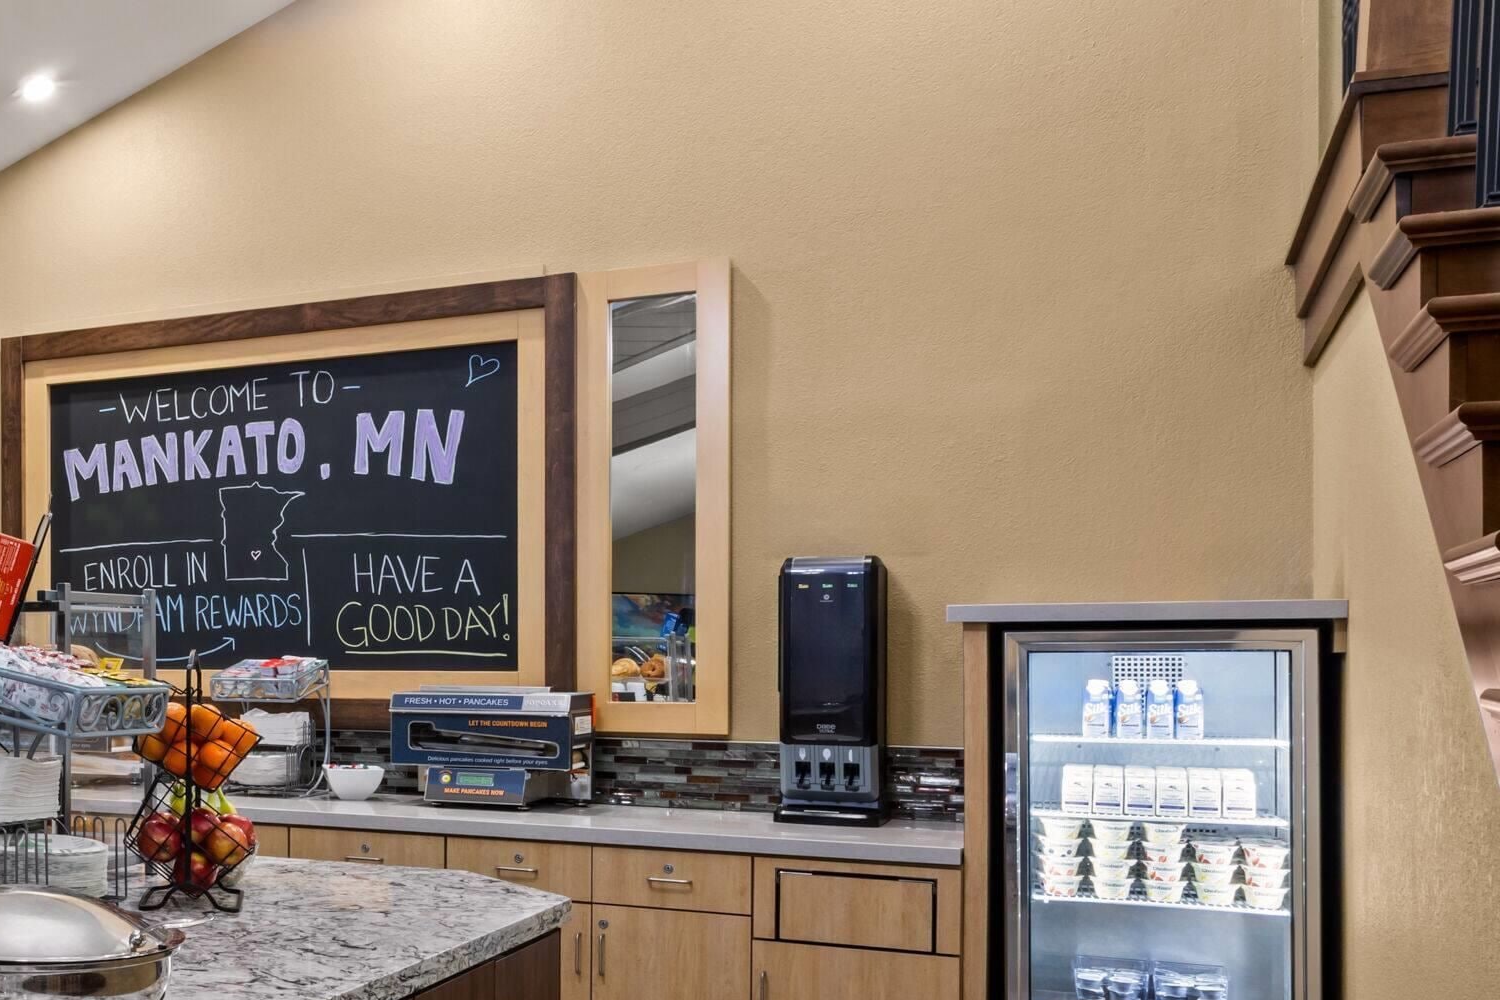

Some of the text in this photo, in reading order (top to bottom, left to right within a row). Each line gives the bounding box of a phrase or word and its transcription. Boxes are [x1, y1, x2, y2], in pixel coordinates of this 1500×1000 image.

[353, 408, 466, 485] MN
[84, 552, 208, 592] ENROLL IN
[353, 552, 482, 596] HAVE A
[194, 592, 302, 633] REWARDS
[336, 593, 511, 648] GOOD DAY!
[404, 697, 509, 706] FRESH HOT PANCAKES
[468, 719, 478, 727] LET
[480, 719, 491, 727] THE
[492, 720, 529, 728] COUNTDOWN
[461, 788, 490, 796] PANCAKES
